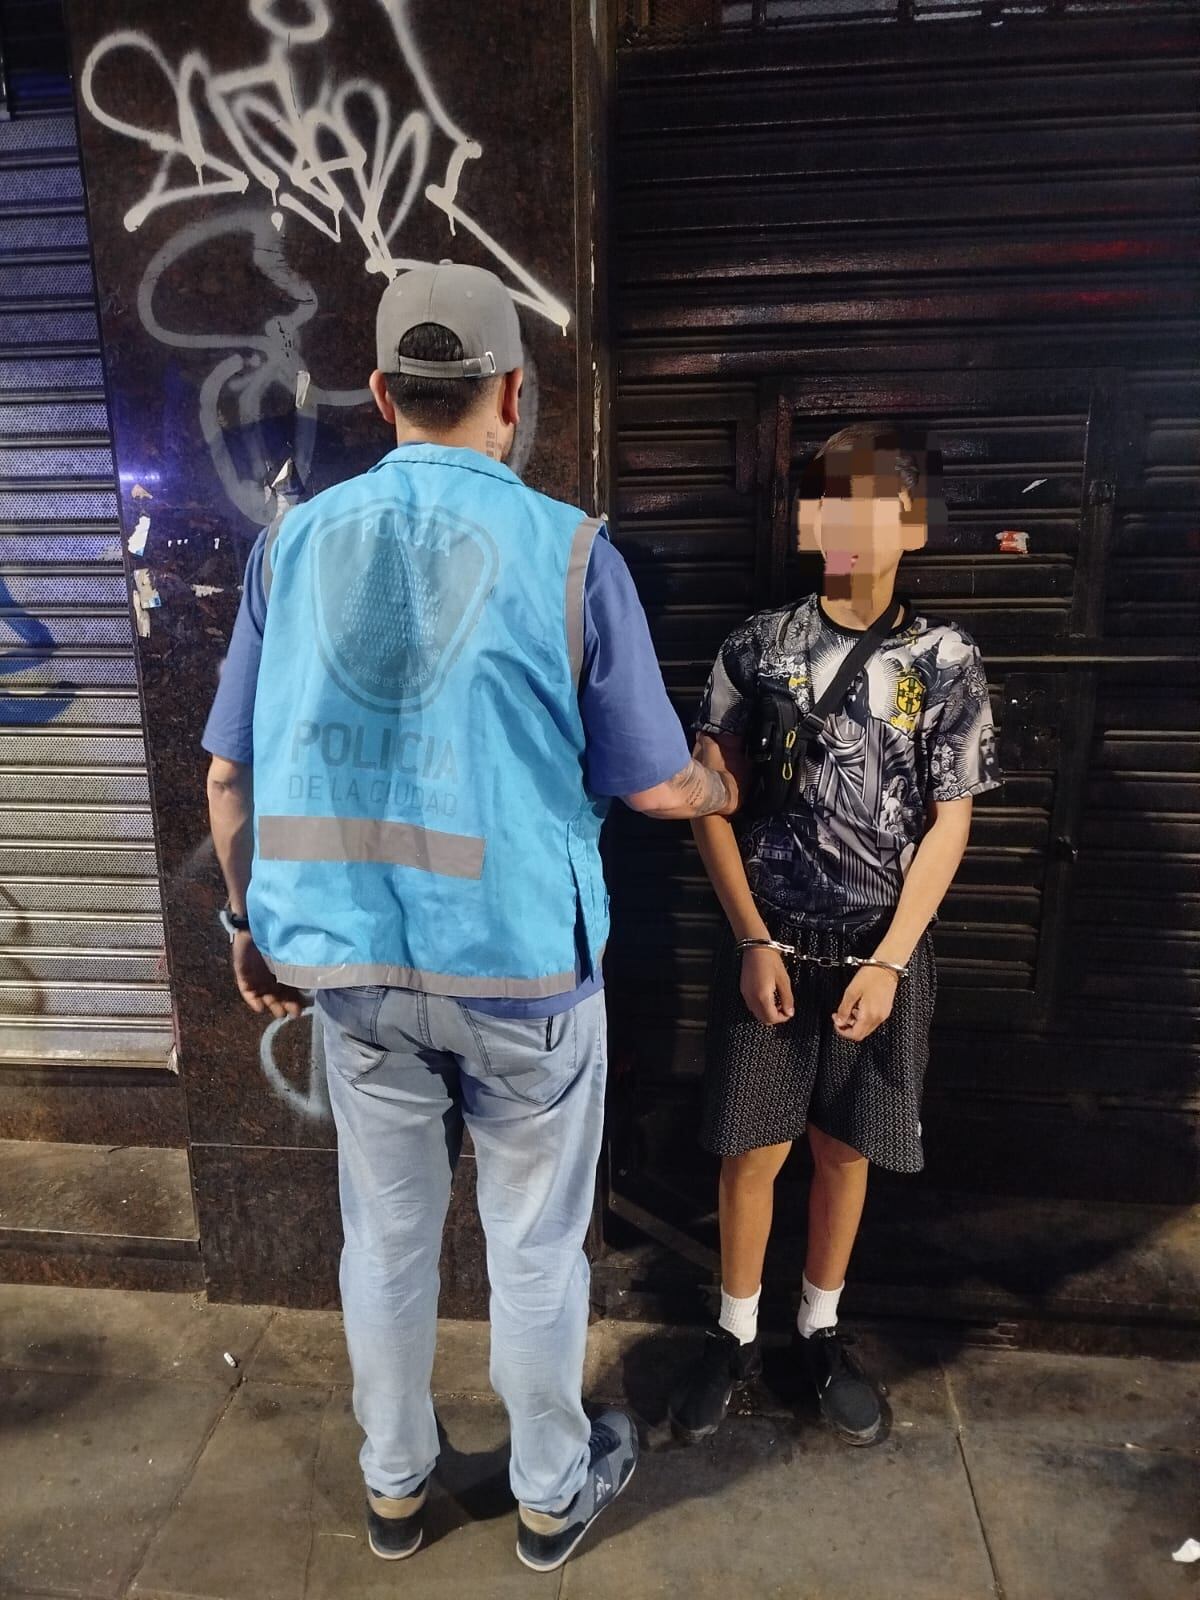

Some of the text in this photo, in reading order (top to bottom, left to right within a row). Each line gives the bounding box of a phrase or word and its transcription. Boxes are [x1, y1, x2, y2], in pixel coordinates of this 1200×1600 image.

[290, 719, 458, 784] POLICIA
[288, 774, 458, 818] DE LA CIUDAD
